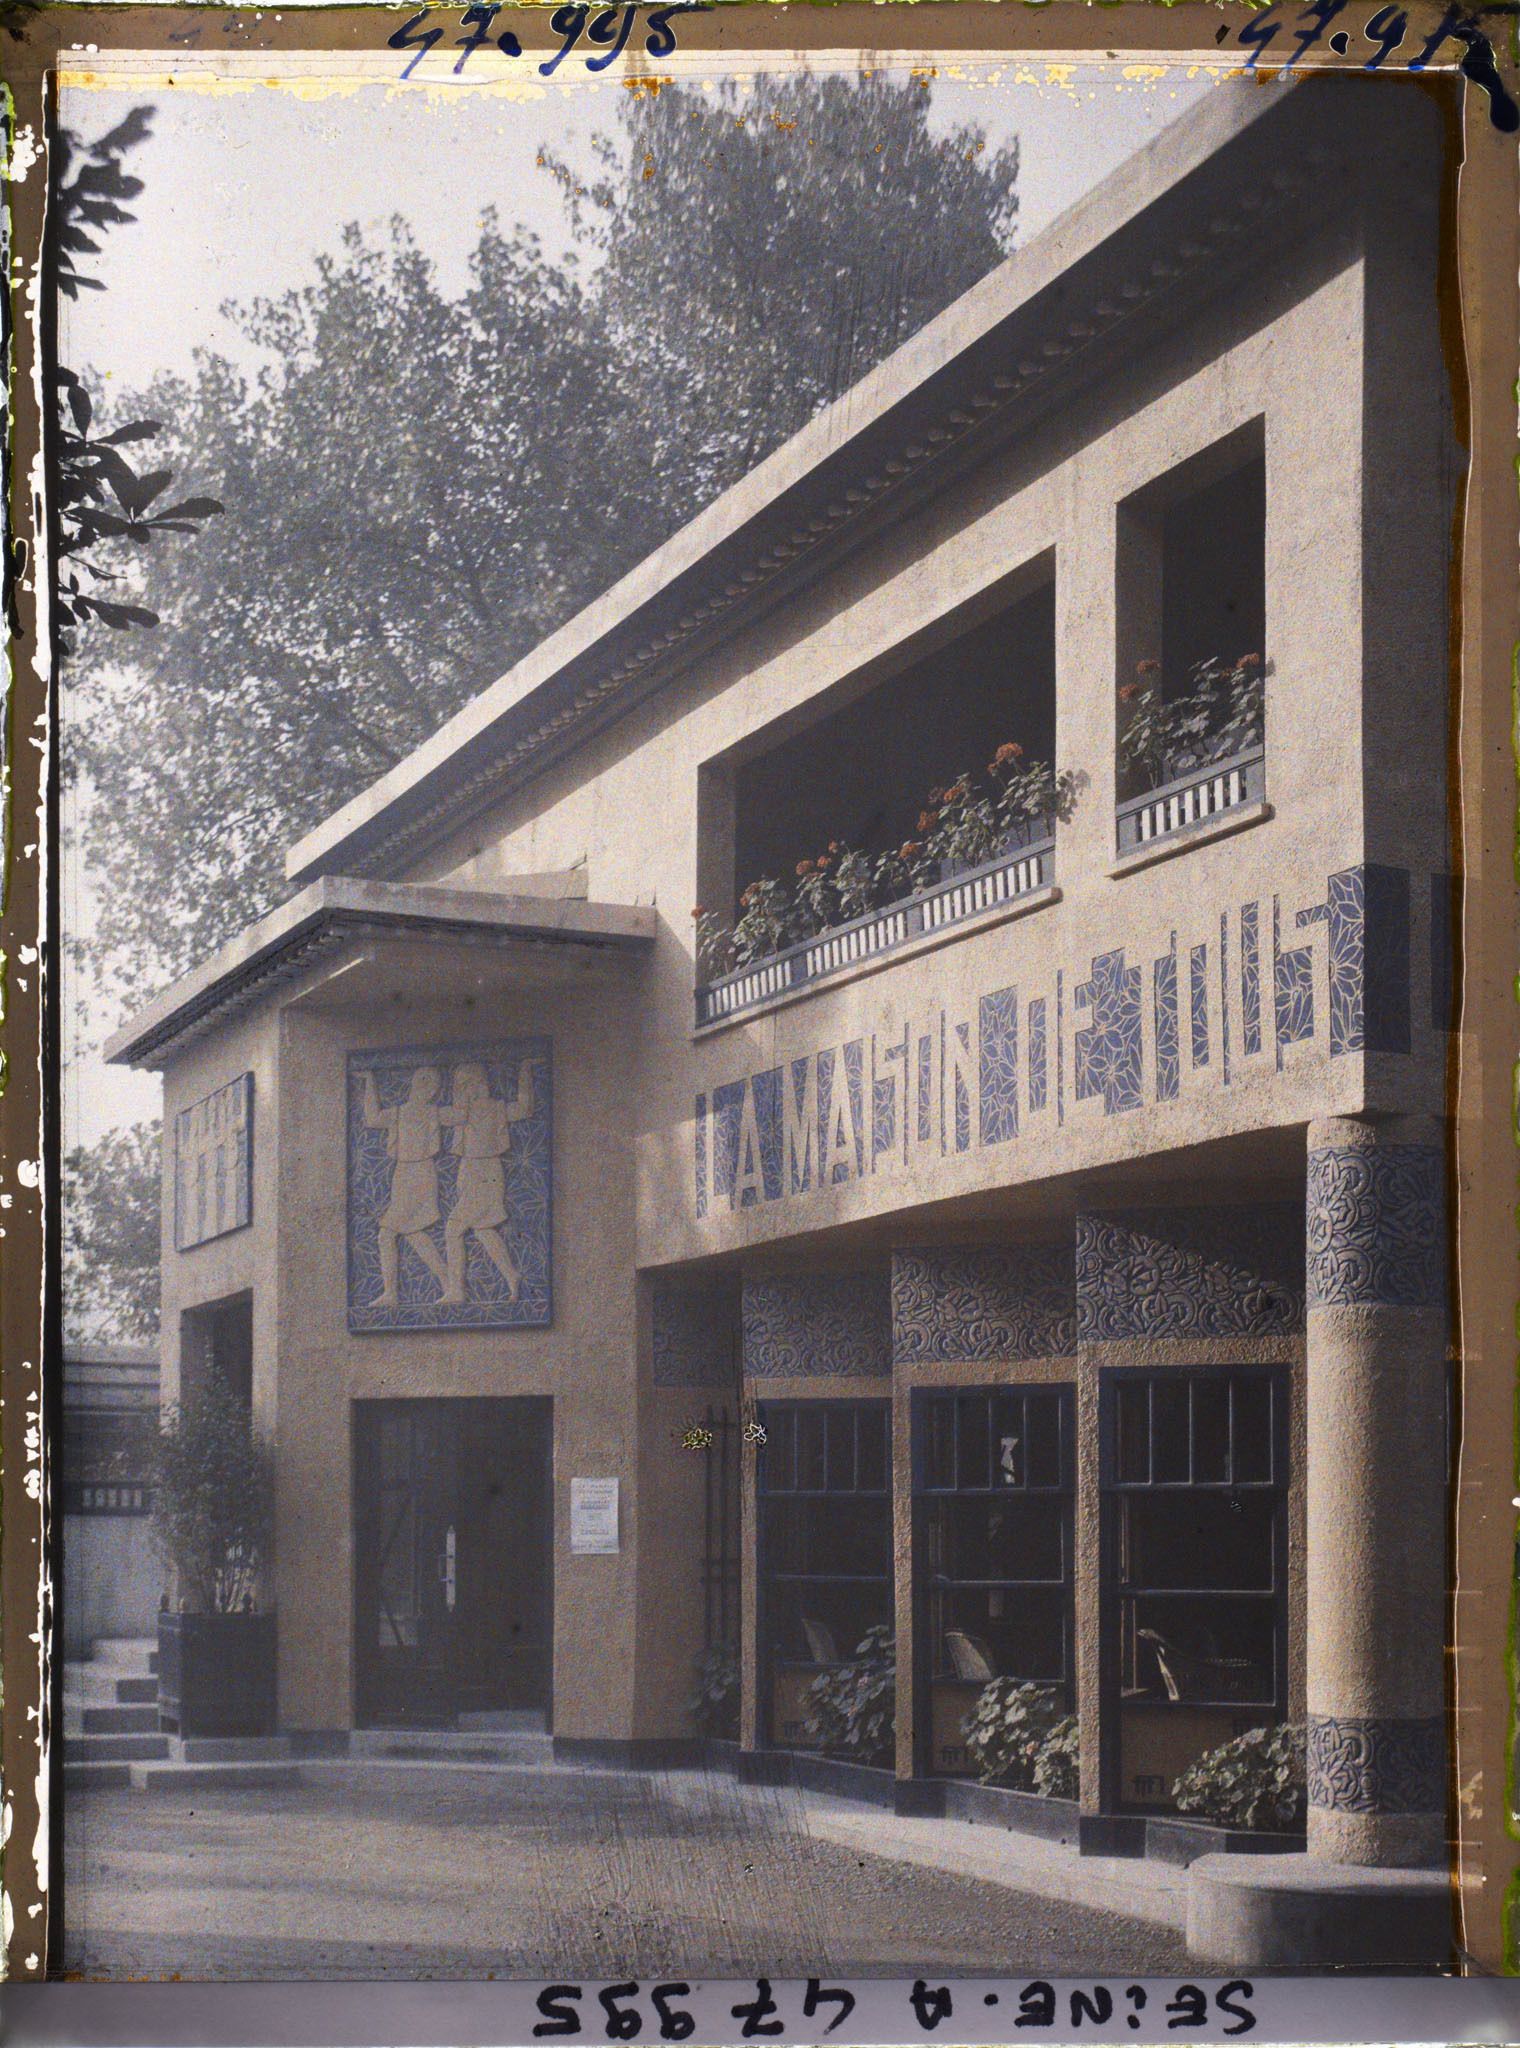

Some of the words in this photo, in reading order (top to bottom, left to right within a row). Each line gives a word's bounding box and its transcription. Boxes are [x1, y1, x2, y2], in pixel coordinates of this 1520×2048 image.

[782, 998, 980, 1198] MAISON
[1018, 950, 1106, 1138] DE
[1124, 876, 1330, 1102] TOUS
[533, 1981, 696, 2040] 995
[731, 1978, 856, 2038] 47
[909, 1979, 953, 2030] A
